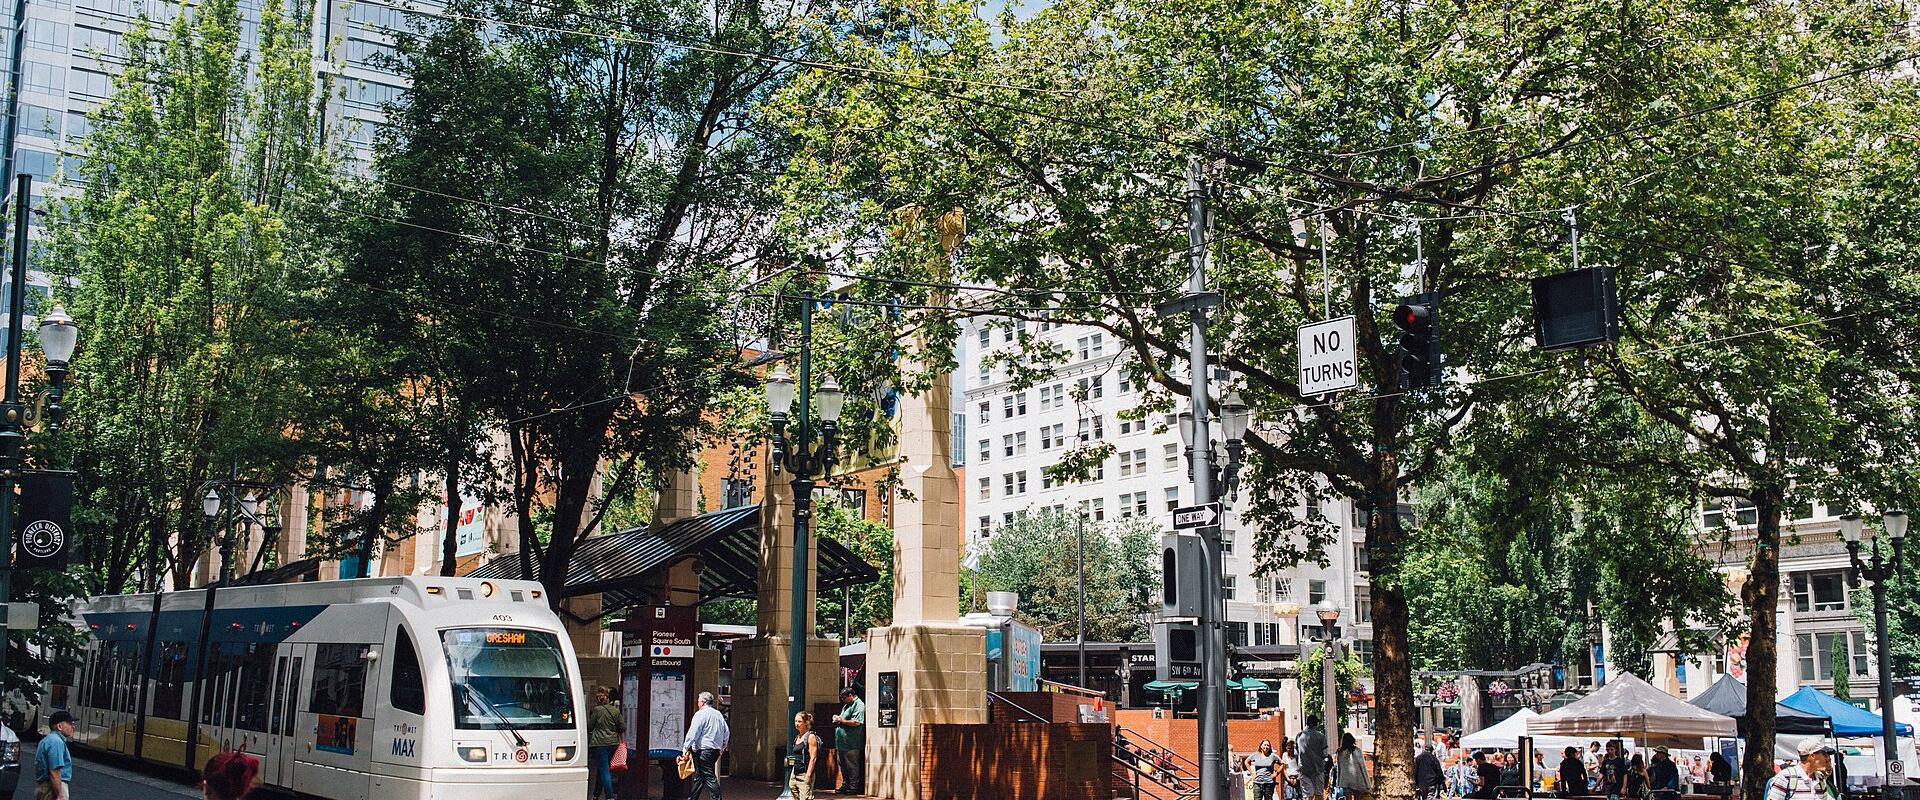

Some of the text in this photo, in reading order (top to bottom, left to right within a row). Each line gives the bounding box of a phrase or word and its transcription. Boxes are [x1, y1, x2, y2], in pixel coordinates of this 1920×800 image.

[1313, 330, 1340, 355] NO
[1303, 360, 1353, 384] TURNS
[1177, 512, 1205, 524] ONE WAY
[25, 523, 61, 546] PIONEER DISTRICT
[492, 614, 513, 622] 403
[486, 633, 525, 644] GRESHAM
[652, 637, 673, 645] Square
[1172, 666, 1181, 675] SW
[1183, 666, 1192, 675] 6th
[391, 738, 416, 757] MAX
